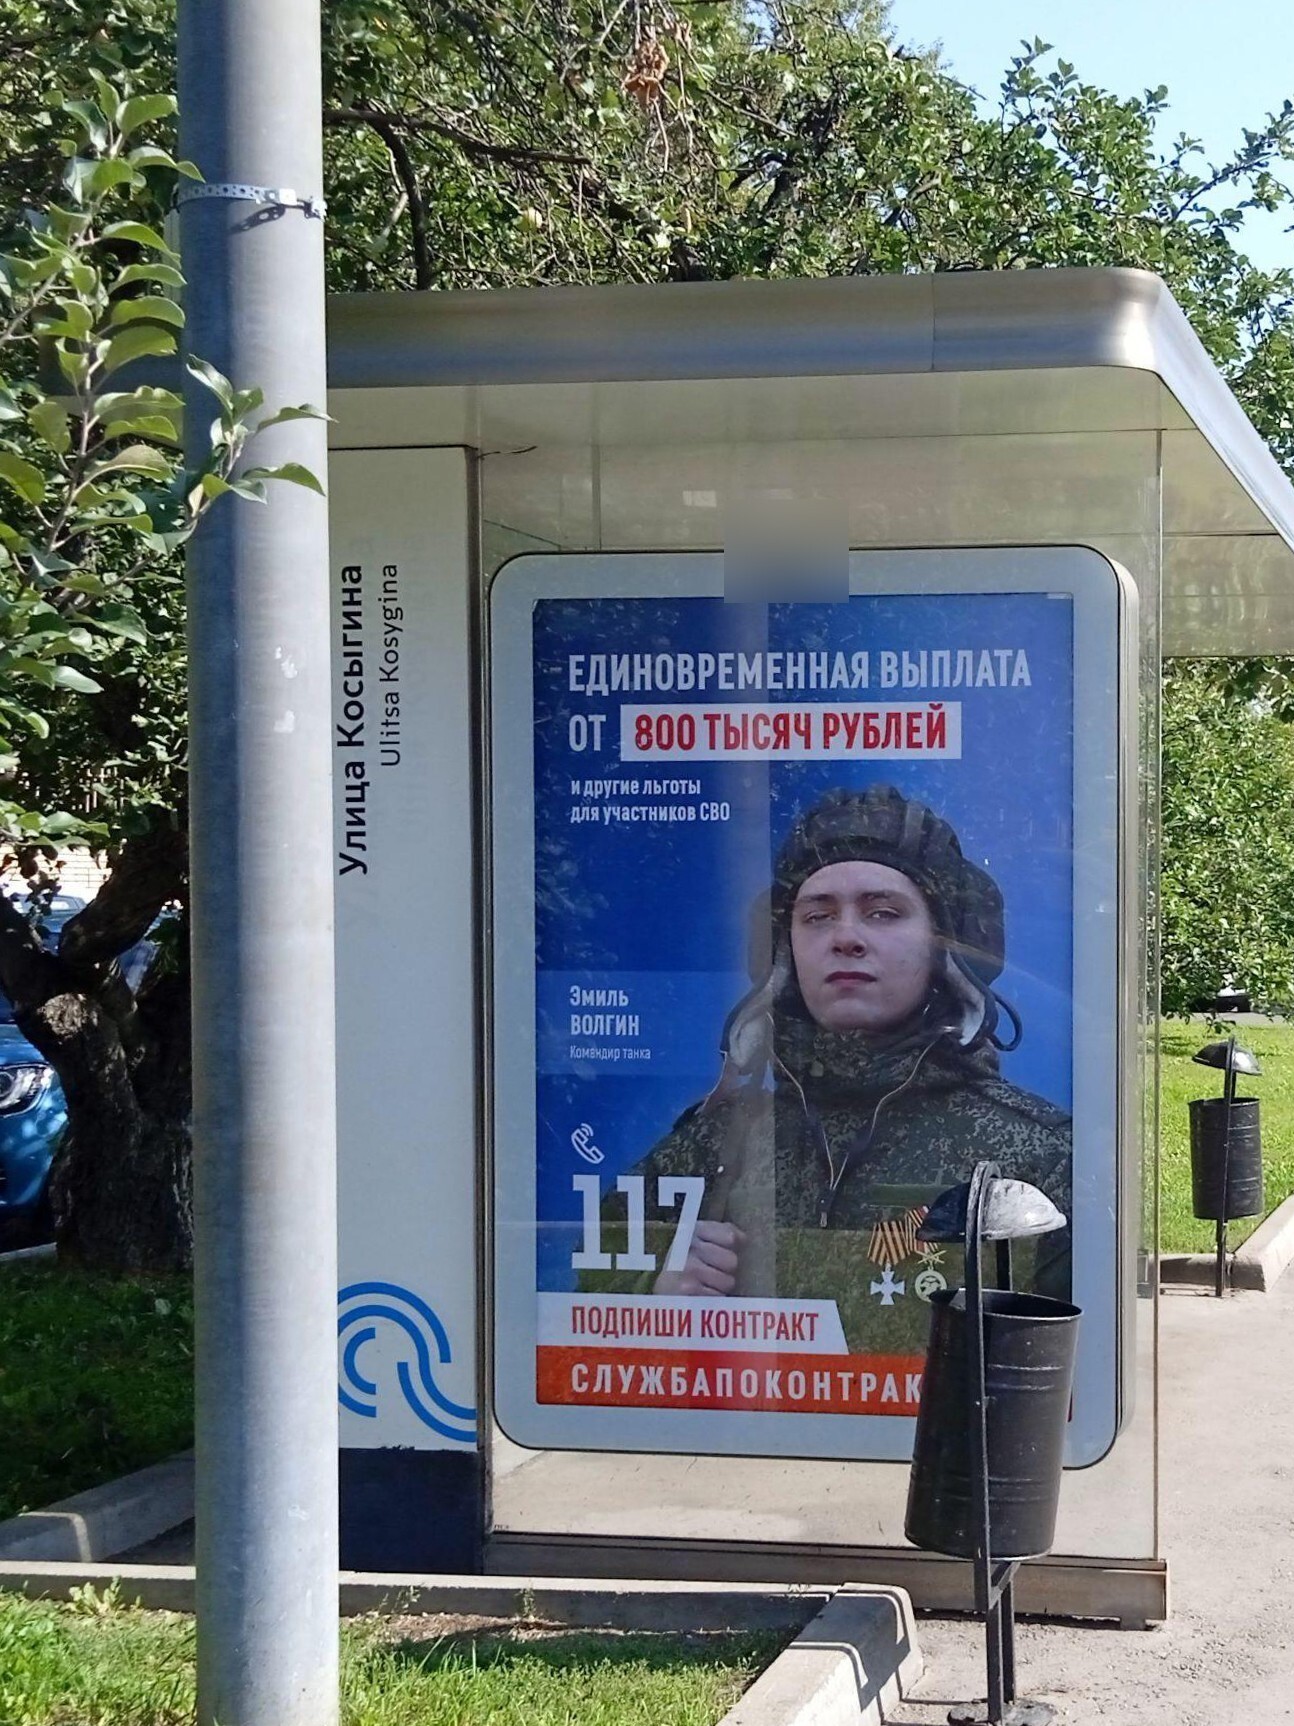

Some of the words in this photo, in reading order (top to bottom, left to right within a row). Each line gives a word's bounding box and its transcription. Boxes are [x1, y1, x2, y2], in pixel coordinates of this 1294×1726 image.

[378, 564, 403, 682] Kosygina
[336, 565, 365, 747] Косыгина
[568, 651, 870, 697] ЕДИНОВРЕМЕННАЯ
[880, 649, 1032, 688] ВЫПЛАТА
[380, 692, 400, 766] Ulitsa
[568, 714, 607, 752] ОТ
[634, 713, 696, 751] 800
[703, 711, 813, 750] ТЫСЯЧ
[822, 702, 947, 750] РУБЛЕЙ
[571, 780, 581, 795] и
[583, 779, 640, 799] другие
[642, 780, 701, 796] льготы
[339, 761, 369, 875] Улица
[570, 806, 600, 823] для
[603, 804, 697, 825] участников
[700, 802, 730, 821] СВО
[569, 985, 629, 1006] Эмиль
[570, 1014, 640, 1036] ВОЛГИН
[571, 1174, 706, 1271] 117
[572, 1306, 692, 1339] ПОДПИШИ
[701, 1310, 819, 1342] КОНТРАКТ
[570, 1363, 922, 1404] СЛУЖБАПОКОНТРАК
